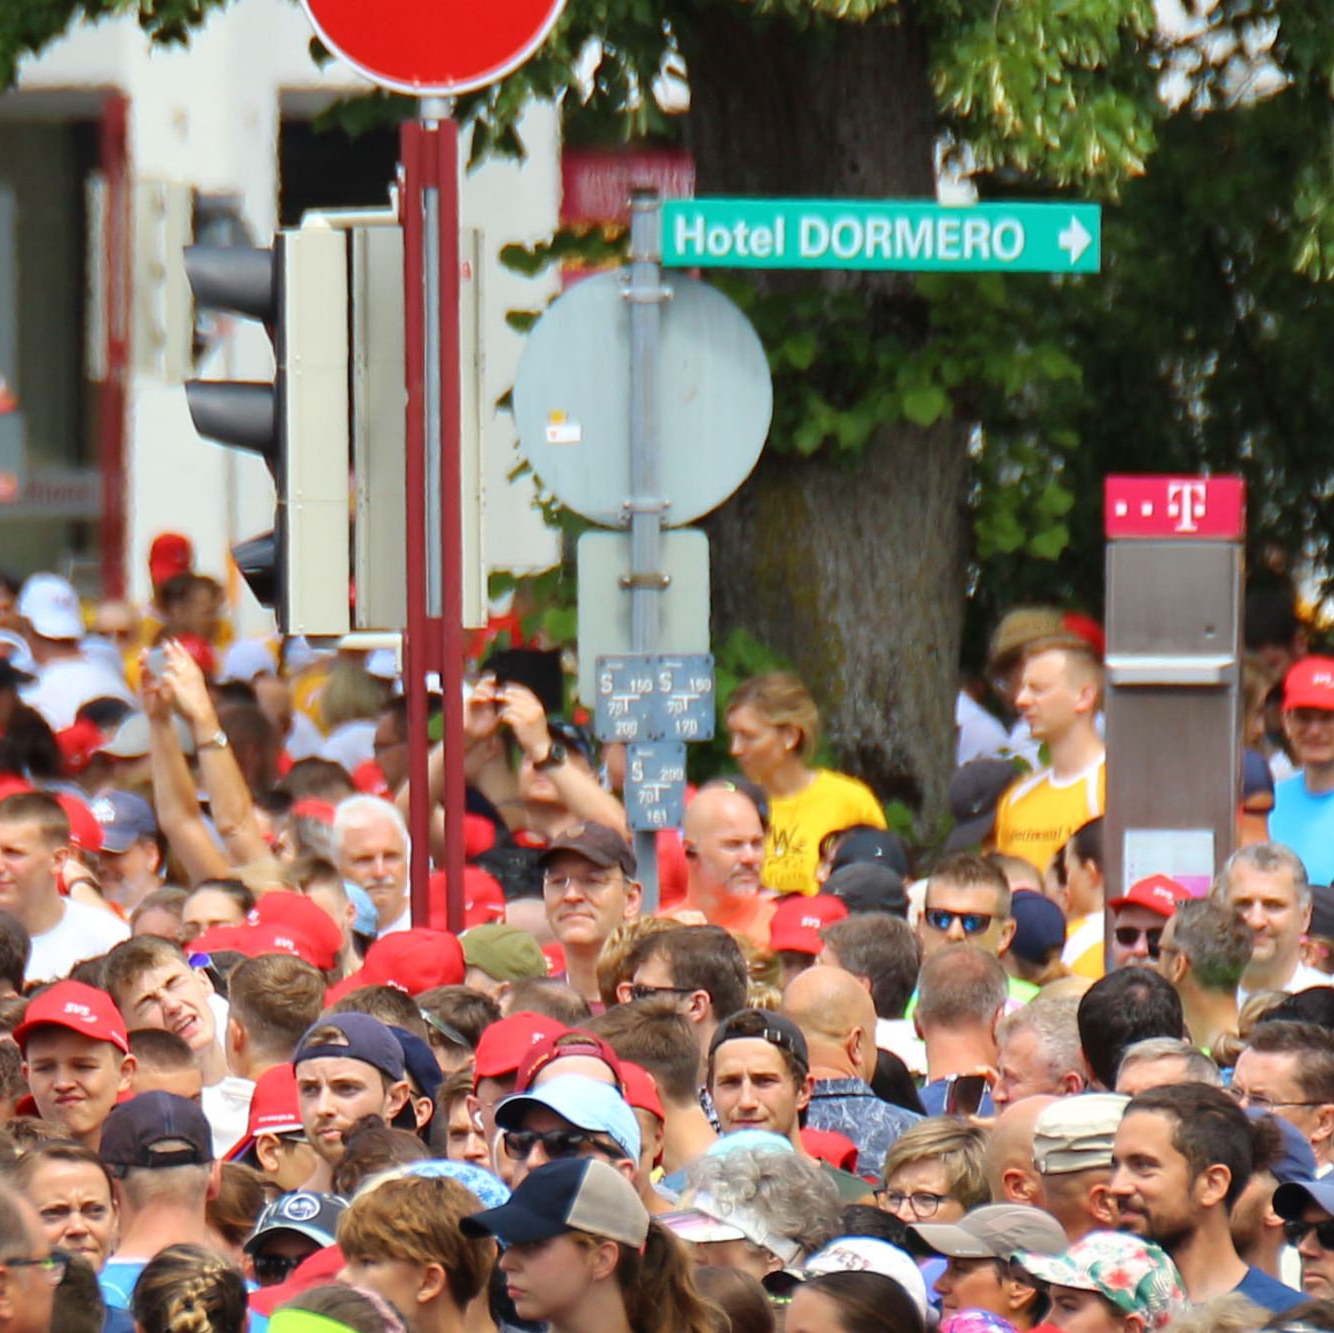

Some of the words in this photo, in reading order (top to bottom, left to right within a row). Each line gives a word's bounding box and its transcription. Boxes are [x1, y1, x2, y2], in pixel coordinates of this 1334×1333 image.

[675, 214, 785, 257] Hotel
[799, 216, 1026, 262] DORMERO
[600, 673, 613, 694] S
[659, 671, 672, 693] S
[631, 760, 643, 782] S
[64, 1001, 90, 1017] SVS
